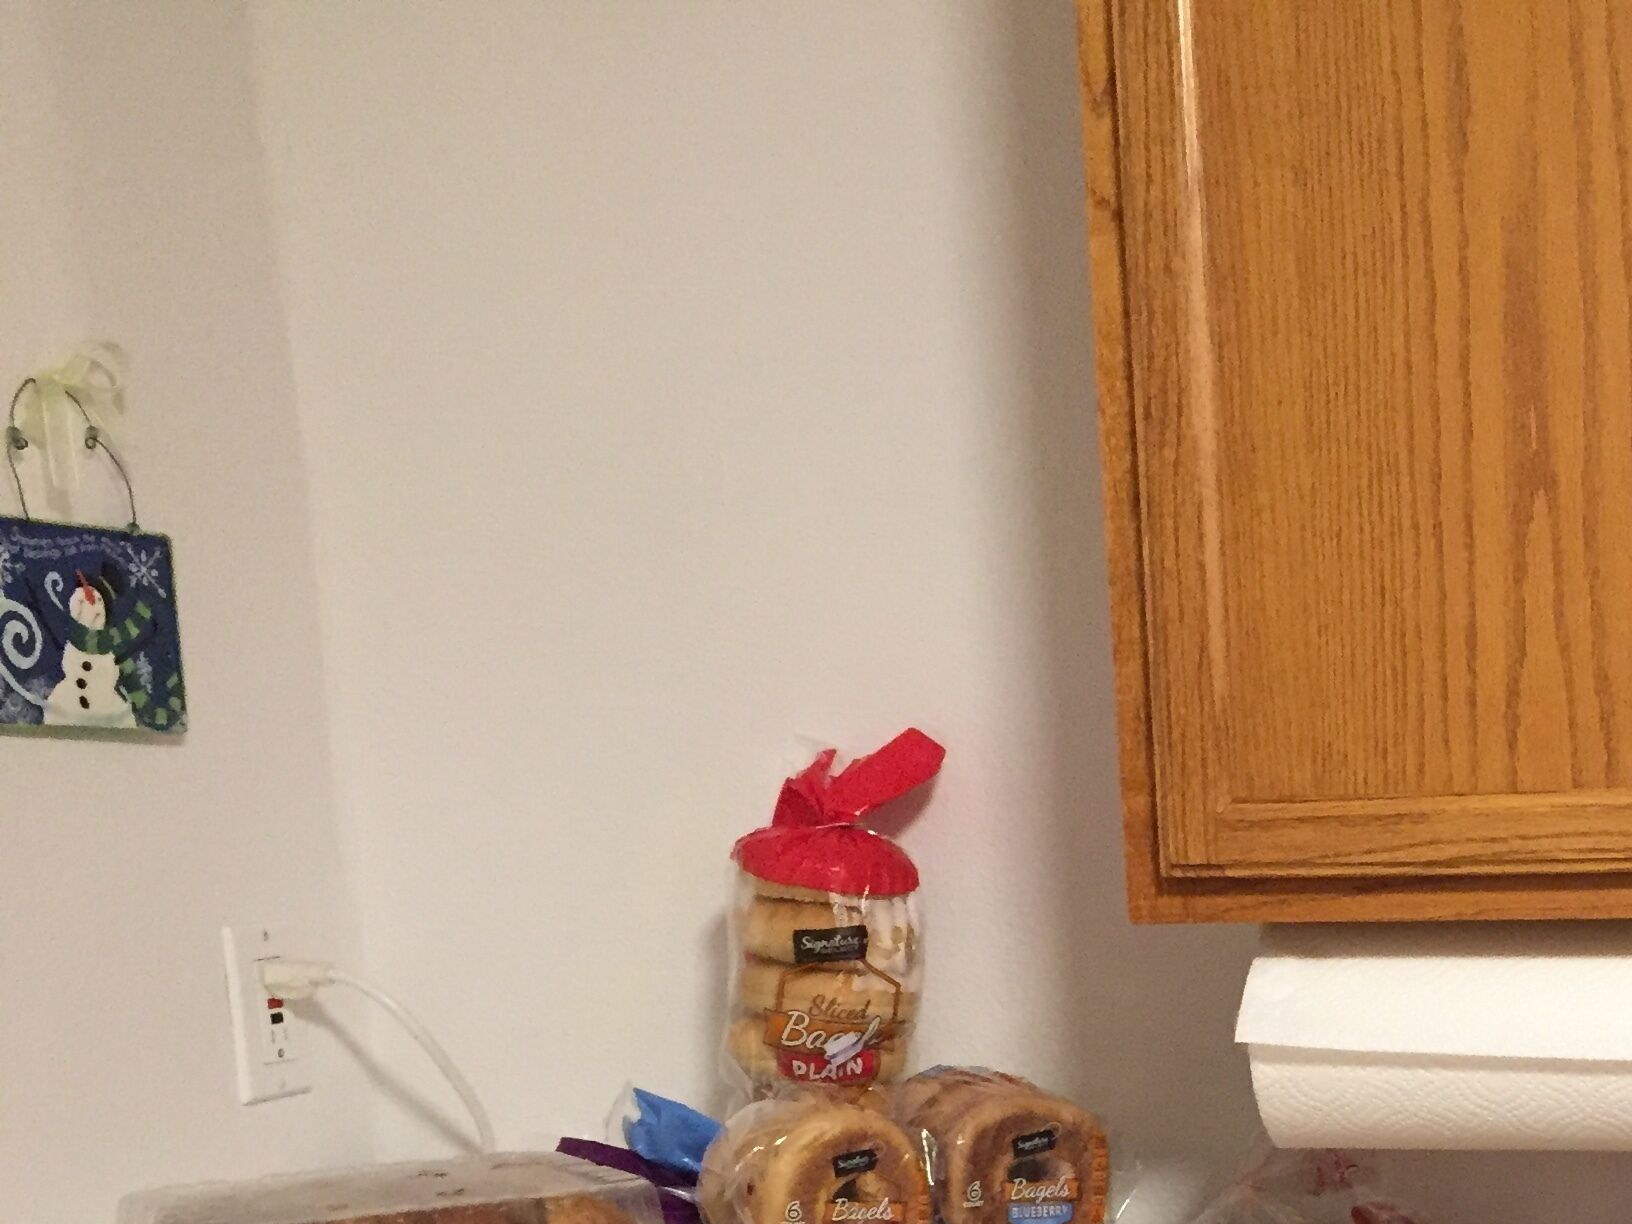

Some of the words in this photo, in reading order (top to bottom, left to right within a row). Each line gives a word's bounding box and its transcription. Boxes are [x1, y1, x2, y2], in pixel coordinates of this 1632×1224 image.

[808, 994, 871, 1019] Sliced
[1011, 1177, 1071, 1203] Bagels
[785, 1201, 803, 1221] 6
[1012, 1206, 1068, 1218] BLUEBERRY
